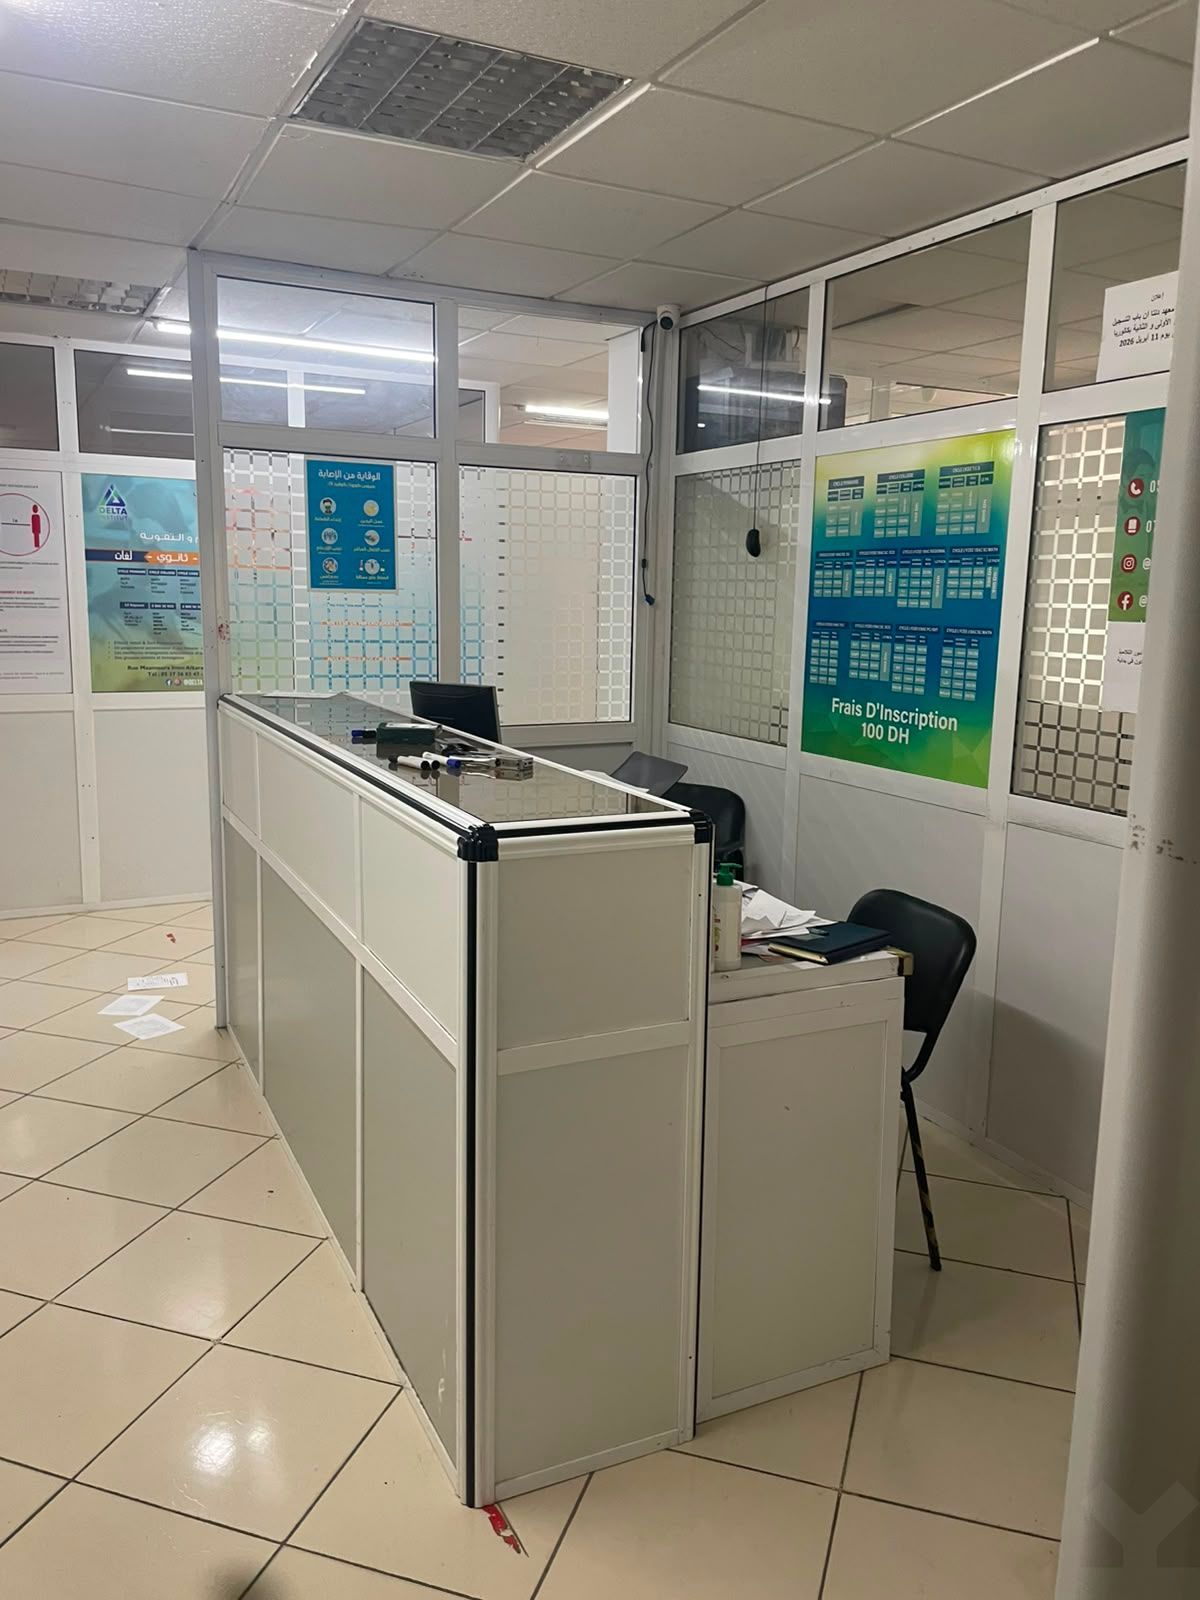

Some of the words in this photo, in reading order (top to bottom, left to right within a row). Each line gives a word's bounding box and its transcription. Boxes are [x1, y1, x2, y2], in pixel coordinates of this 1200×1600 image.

[1162, 307, 1175, 316] معهد
[1151, 333, 1158, 341] 11
[1119, 338, 1134, 347] 2026
[318, 469, 342, 480] الإصابة
[343, 472, 356, 480] من
[357, 471, 381, 482] الوقاية
[98, 507, 128, 515] DELTA
[186, 536, 193, 544] و
[114, 549, 133, 561] لغات
[156, 553, 189, 564] ثانوي
[831, 697, 863, 717] Frais
[866, 702, 958, 732] D'Inscription
[861, 722, 884, 740] 100
[888, 726, 910, 745] DH
